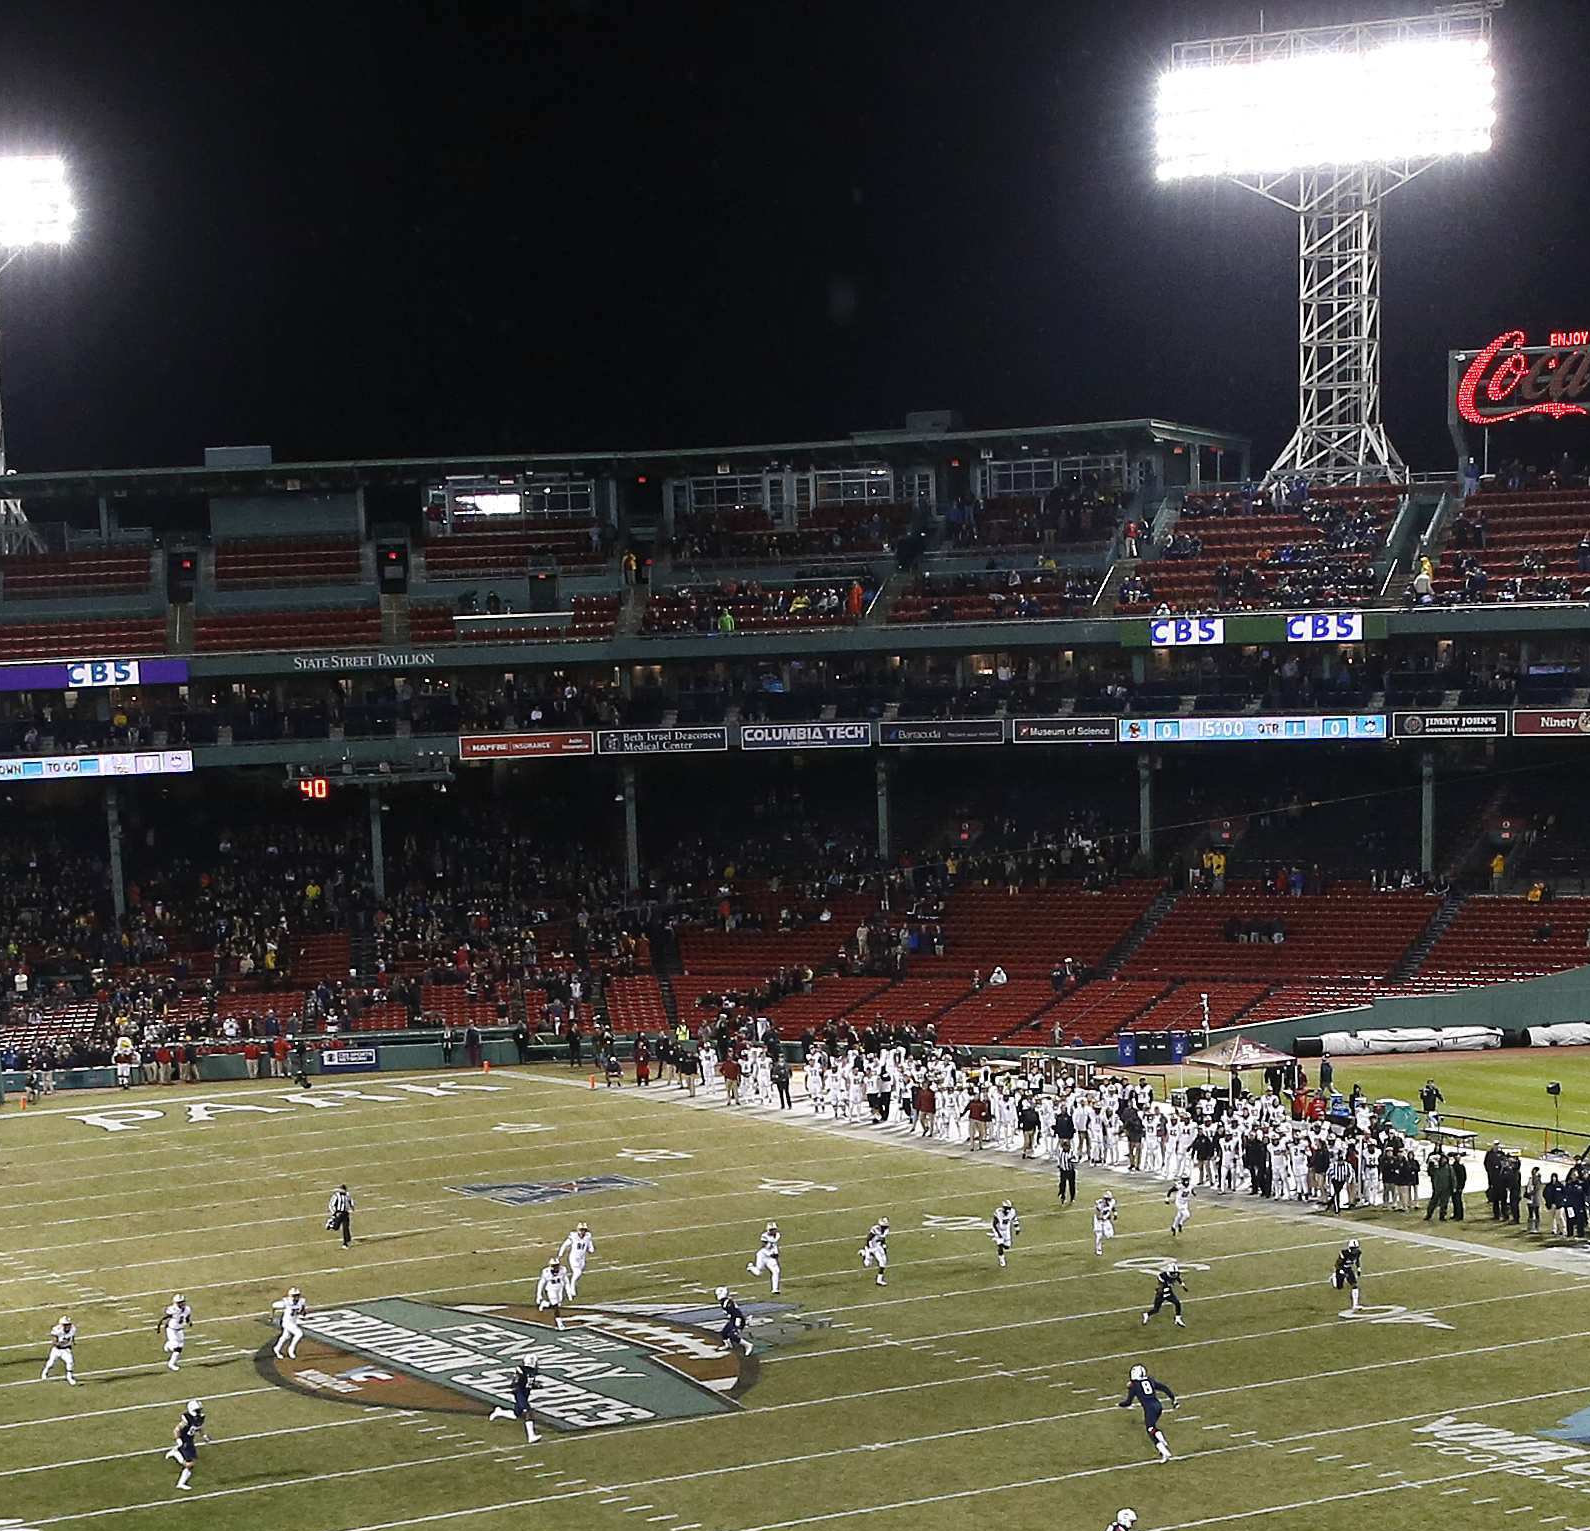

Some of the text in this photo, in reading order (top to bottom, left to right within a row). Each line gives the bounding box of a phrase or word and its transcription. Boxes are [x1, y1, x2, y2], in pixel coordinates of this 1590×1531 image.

[1550, 331, 1588, 346] ENJOY
[1150, 619, 1216, 644] CBS
[1287, 614, 1354, 639] CBS
[294, 653, 435, 670] STATE STREET PAVILION
[68, 661, 131, 683] CBS
[1199, 721, 1244, 737] 15:00
[1425, 716, 1497, 728] JIMMY JOHN'S
[1541, 716, 1578, 729] Ninety
[623, 731, 721, 743] Beth Israel Deaconess
[744, 726, 865, 742] COLUMBIA TECH
[1030, 725, 1110, 737] Museum of Science
[624, 741, 694, 752] Medical Center
[47, 762, 61, 773] TO
[63, 762, 78, 773] GO
[300, 778, 327, 798] 40
[64, 1080, 511, 1132] PARK
[296, 1308, 502, 1374] GRIDIRON
[430, 1322, 647, 1382] FENWAY
[1140, 1379, 1153, 1395] 8
